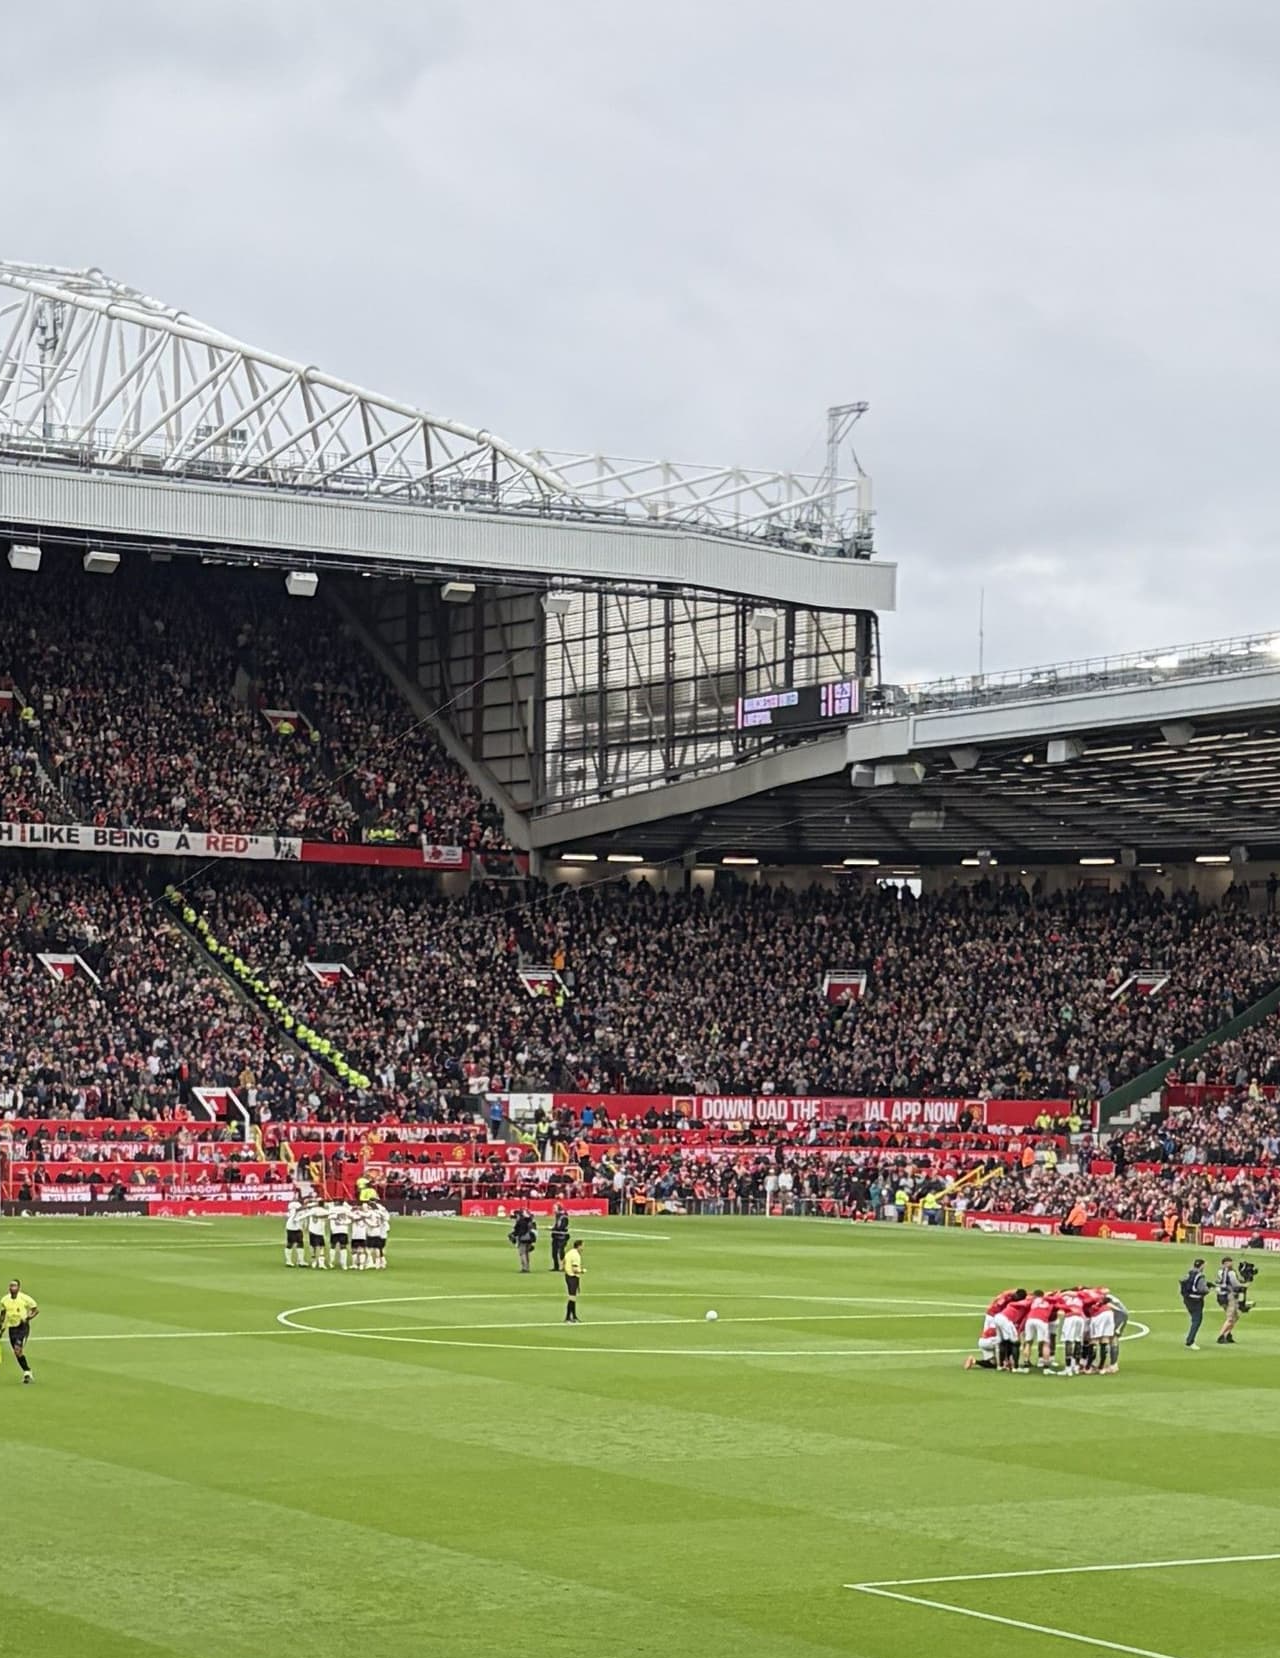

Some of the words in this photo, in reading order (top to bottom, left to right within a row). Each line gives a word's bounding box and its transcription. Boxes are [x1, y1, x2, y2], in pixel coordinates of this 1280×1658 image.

[28, 823, 80, 846] LIKE
[93, 827, 160, 850] BEING
[175, 832, 191, 851] A
[205, 832, 260, 855] RED"
[702, 1099, 788, 1120] DOWNLOAD
[791, 1100, 819, 1120] THE
[891, 1101, 922, 1121] APP
[924, 1102, 958, 1122] NOW
